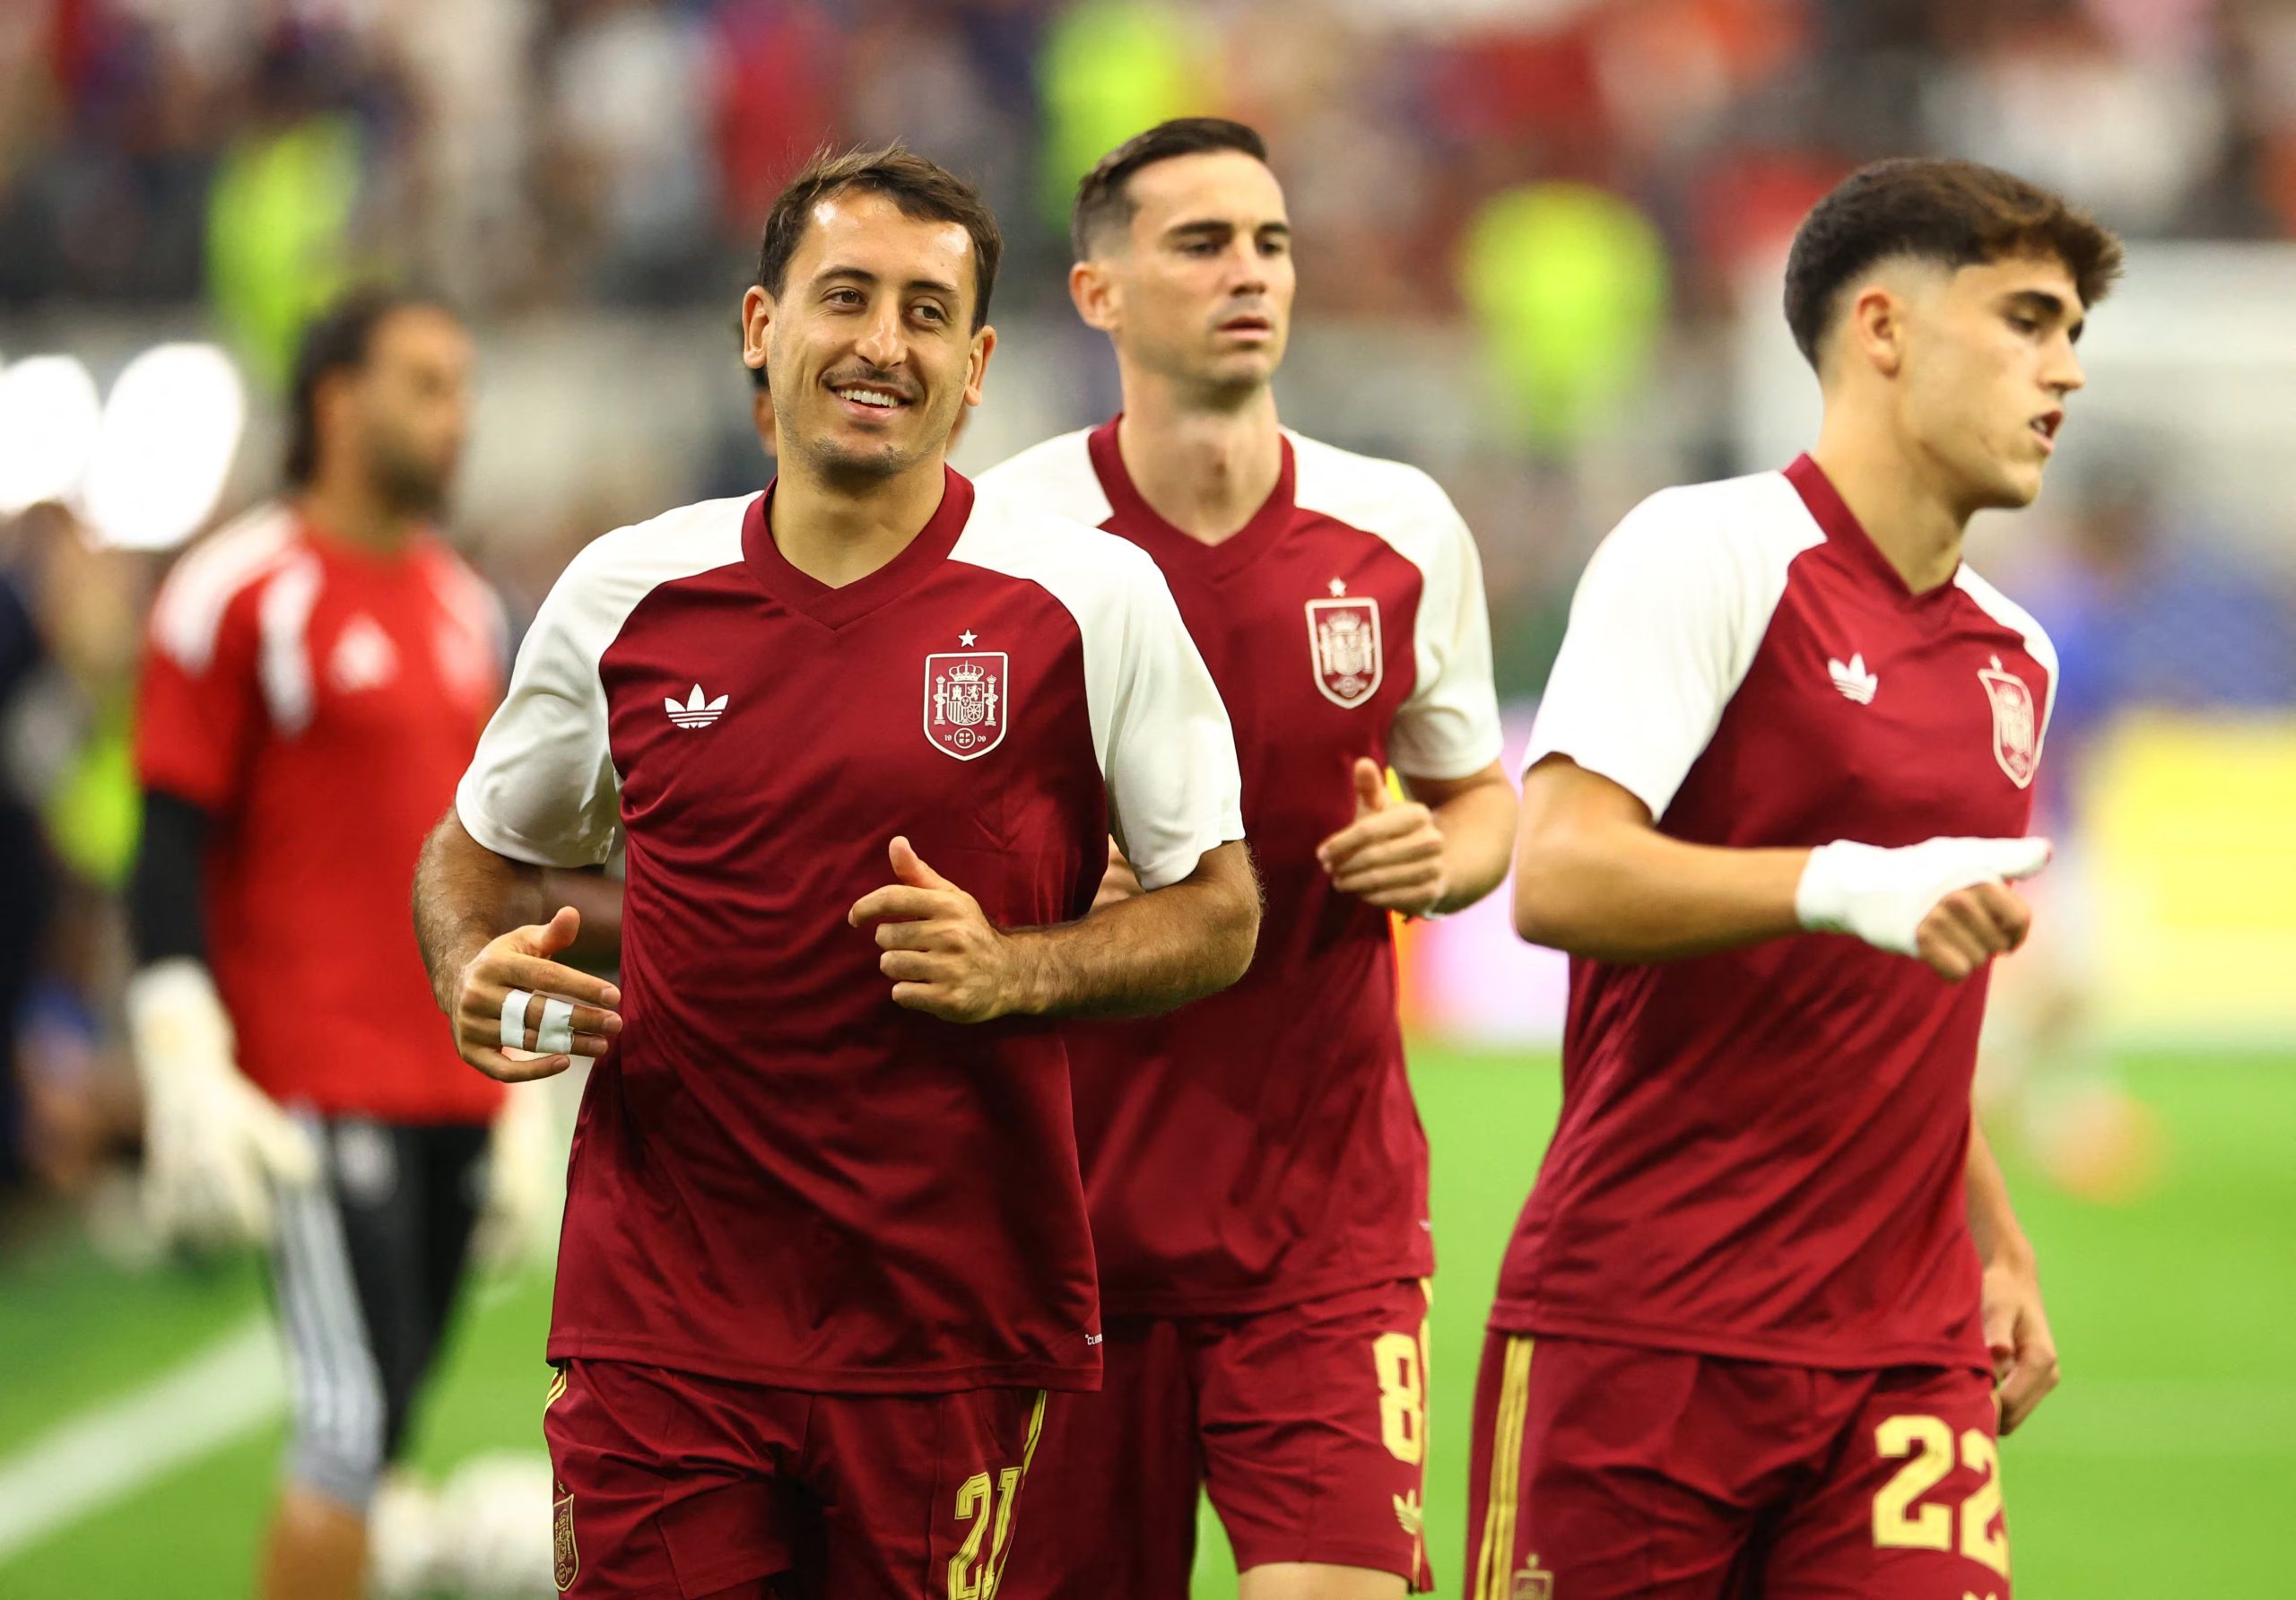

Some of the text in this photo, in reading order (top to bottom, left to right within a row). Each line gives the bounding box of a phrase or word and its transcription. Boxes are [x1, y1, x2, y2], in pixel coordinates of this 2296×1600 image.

[1372, 1332, 1423, 1466] 8
[948, 1466, 1022, 1600] 21
[1872, 1414, 2011, 1583] 22
